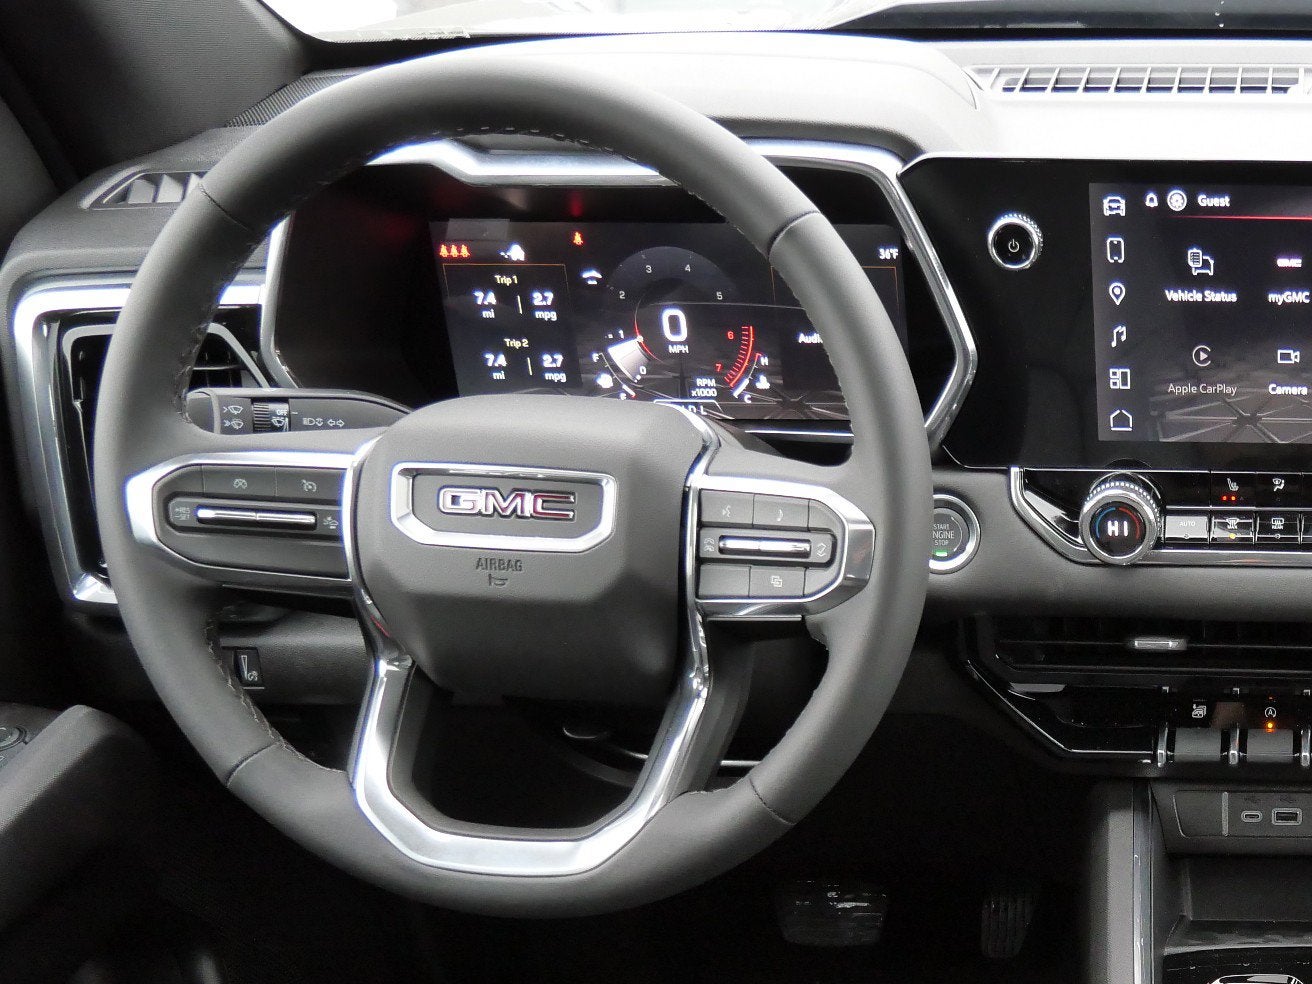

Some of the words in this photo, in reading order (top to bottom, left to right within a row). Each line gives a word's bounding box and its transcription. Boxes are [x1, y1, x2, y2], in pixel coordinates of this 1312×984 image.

[1197, 194, 1231, 207] Guest
[494, 274, 513, 287] Trip
[532, 291, 554, 306] 2.7
[1164, 289, 1203, 302] Vehicle
[1203, 289, 1238, 303] Status
[1269, 291, 1310, 305] myGMC
[482, 308, 495, 319] mi
[534, 310, 558, 322] mpg
[662, 309, 687, 341] 0
[503, 338, 522, 350] Trip
[668, 344, 689, 354] MPH
[542, 353, 564, 368] 2.7
[492, 370, 506, 380] mi
[544, 372, 567, 383] mpg
[696, 377, 717, 387] RPM
[1167, 382, 1198, 396] Apple
[1199, 383, 1237, 397] CarPlay
[1268, 383, 1308, 396] Camera
[439, 486, 575, 521] GMC
[932, 530, 955, 538] NGINE
[1108, 521, 1128, 536] HI
[475, 557, 522, 572] AIRBAG
